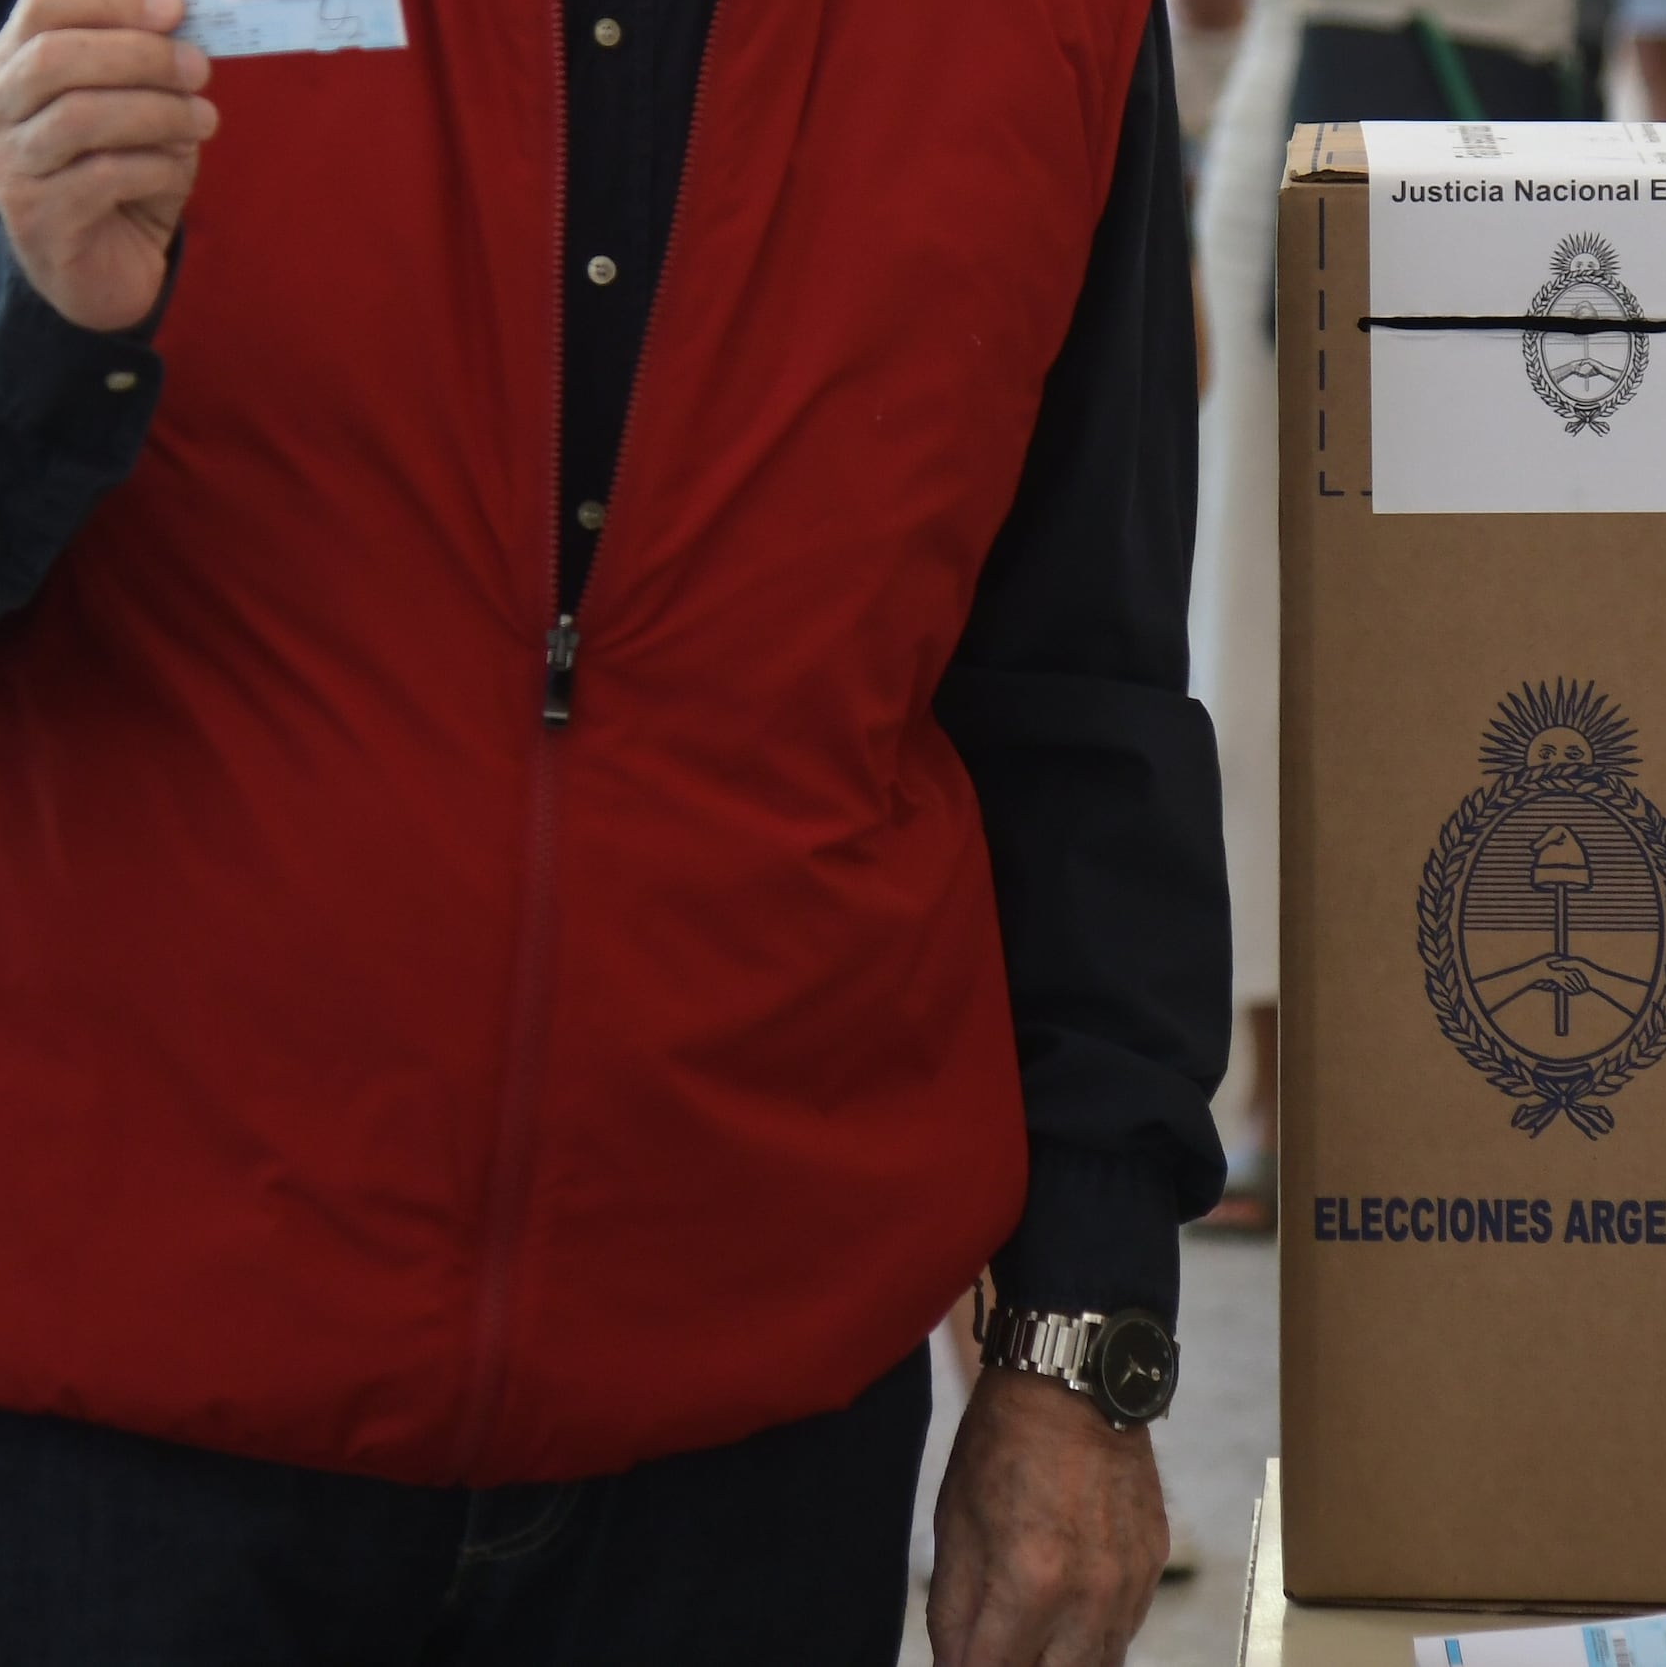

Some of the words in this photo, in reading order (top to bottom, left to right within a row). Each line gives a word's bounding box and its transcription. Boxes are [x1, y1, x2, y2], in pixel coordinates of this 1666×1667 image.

[1391, 178, 1505, 203] Justicia
[1514, 177, 1640, 203] Nacional
[1314, 1196, 1553, 1244] ELECCIONES
